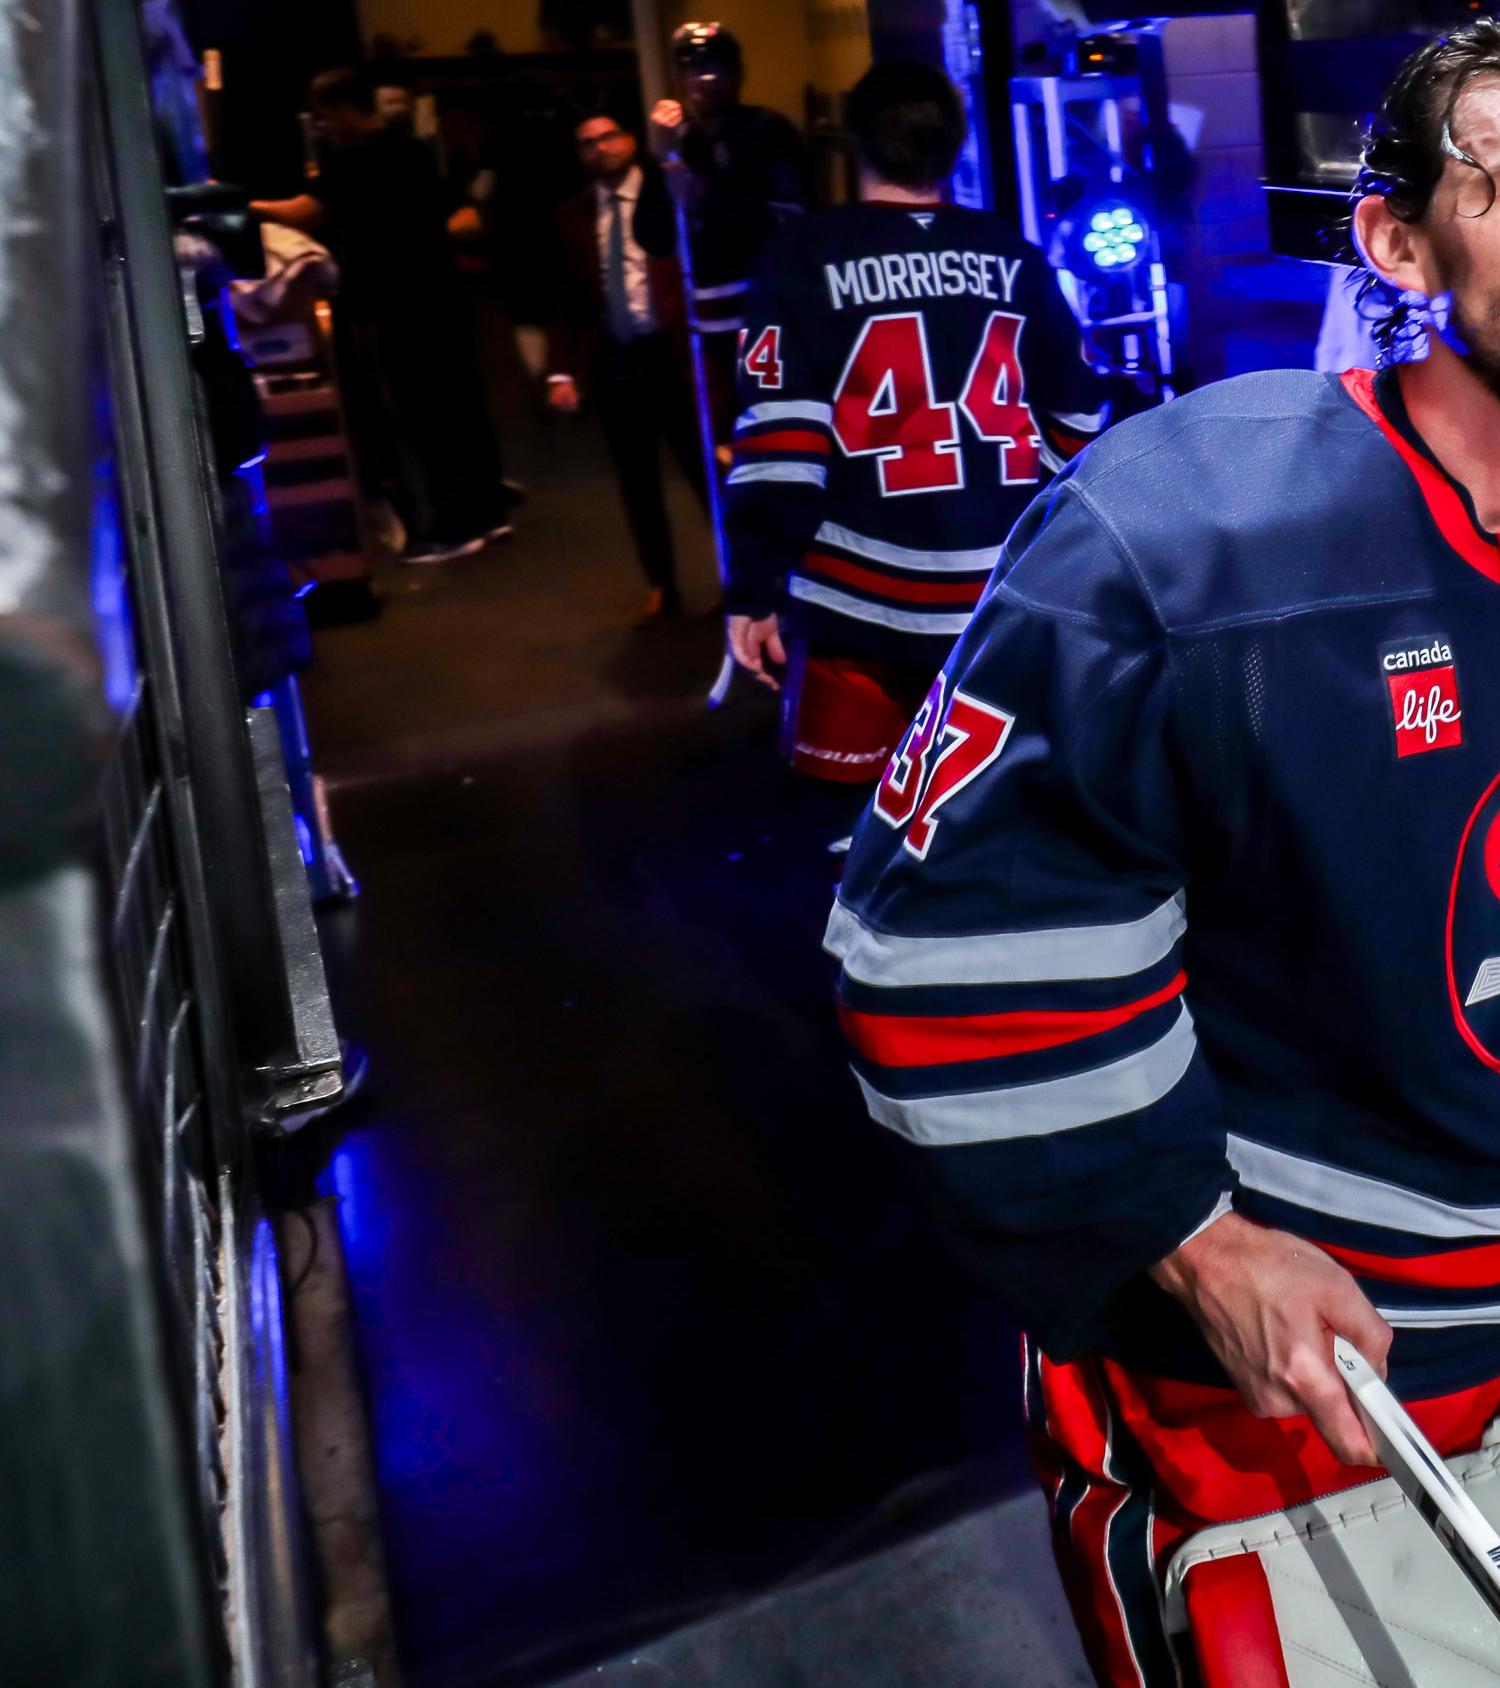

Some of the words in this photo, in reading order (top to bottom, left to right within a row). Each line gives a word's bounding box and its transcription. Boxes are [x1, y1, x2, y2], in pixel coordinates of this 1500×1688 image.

[824, 250, 1022, 310] MORRISSEY
[832, 309, 1041, 497] 44
[1383, 640, 1452, 671] canada
[1395, 685, 1462, 743] life
[872, 669, 1016, 863] 37
